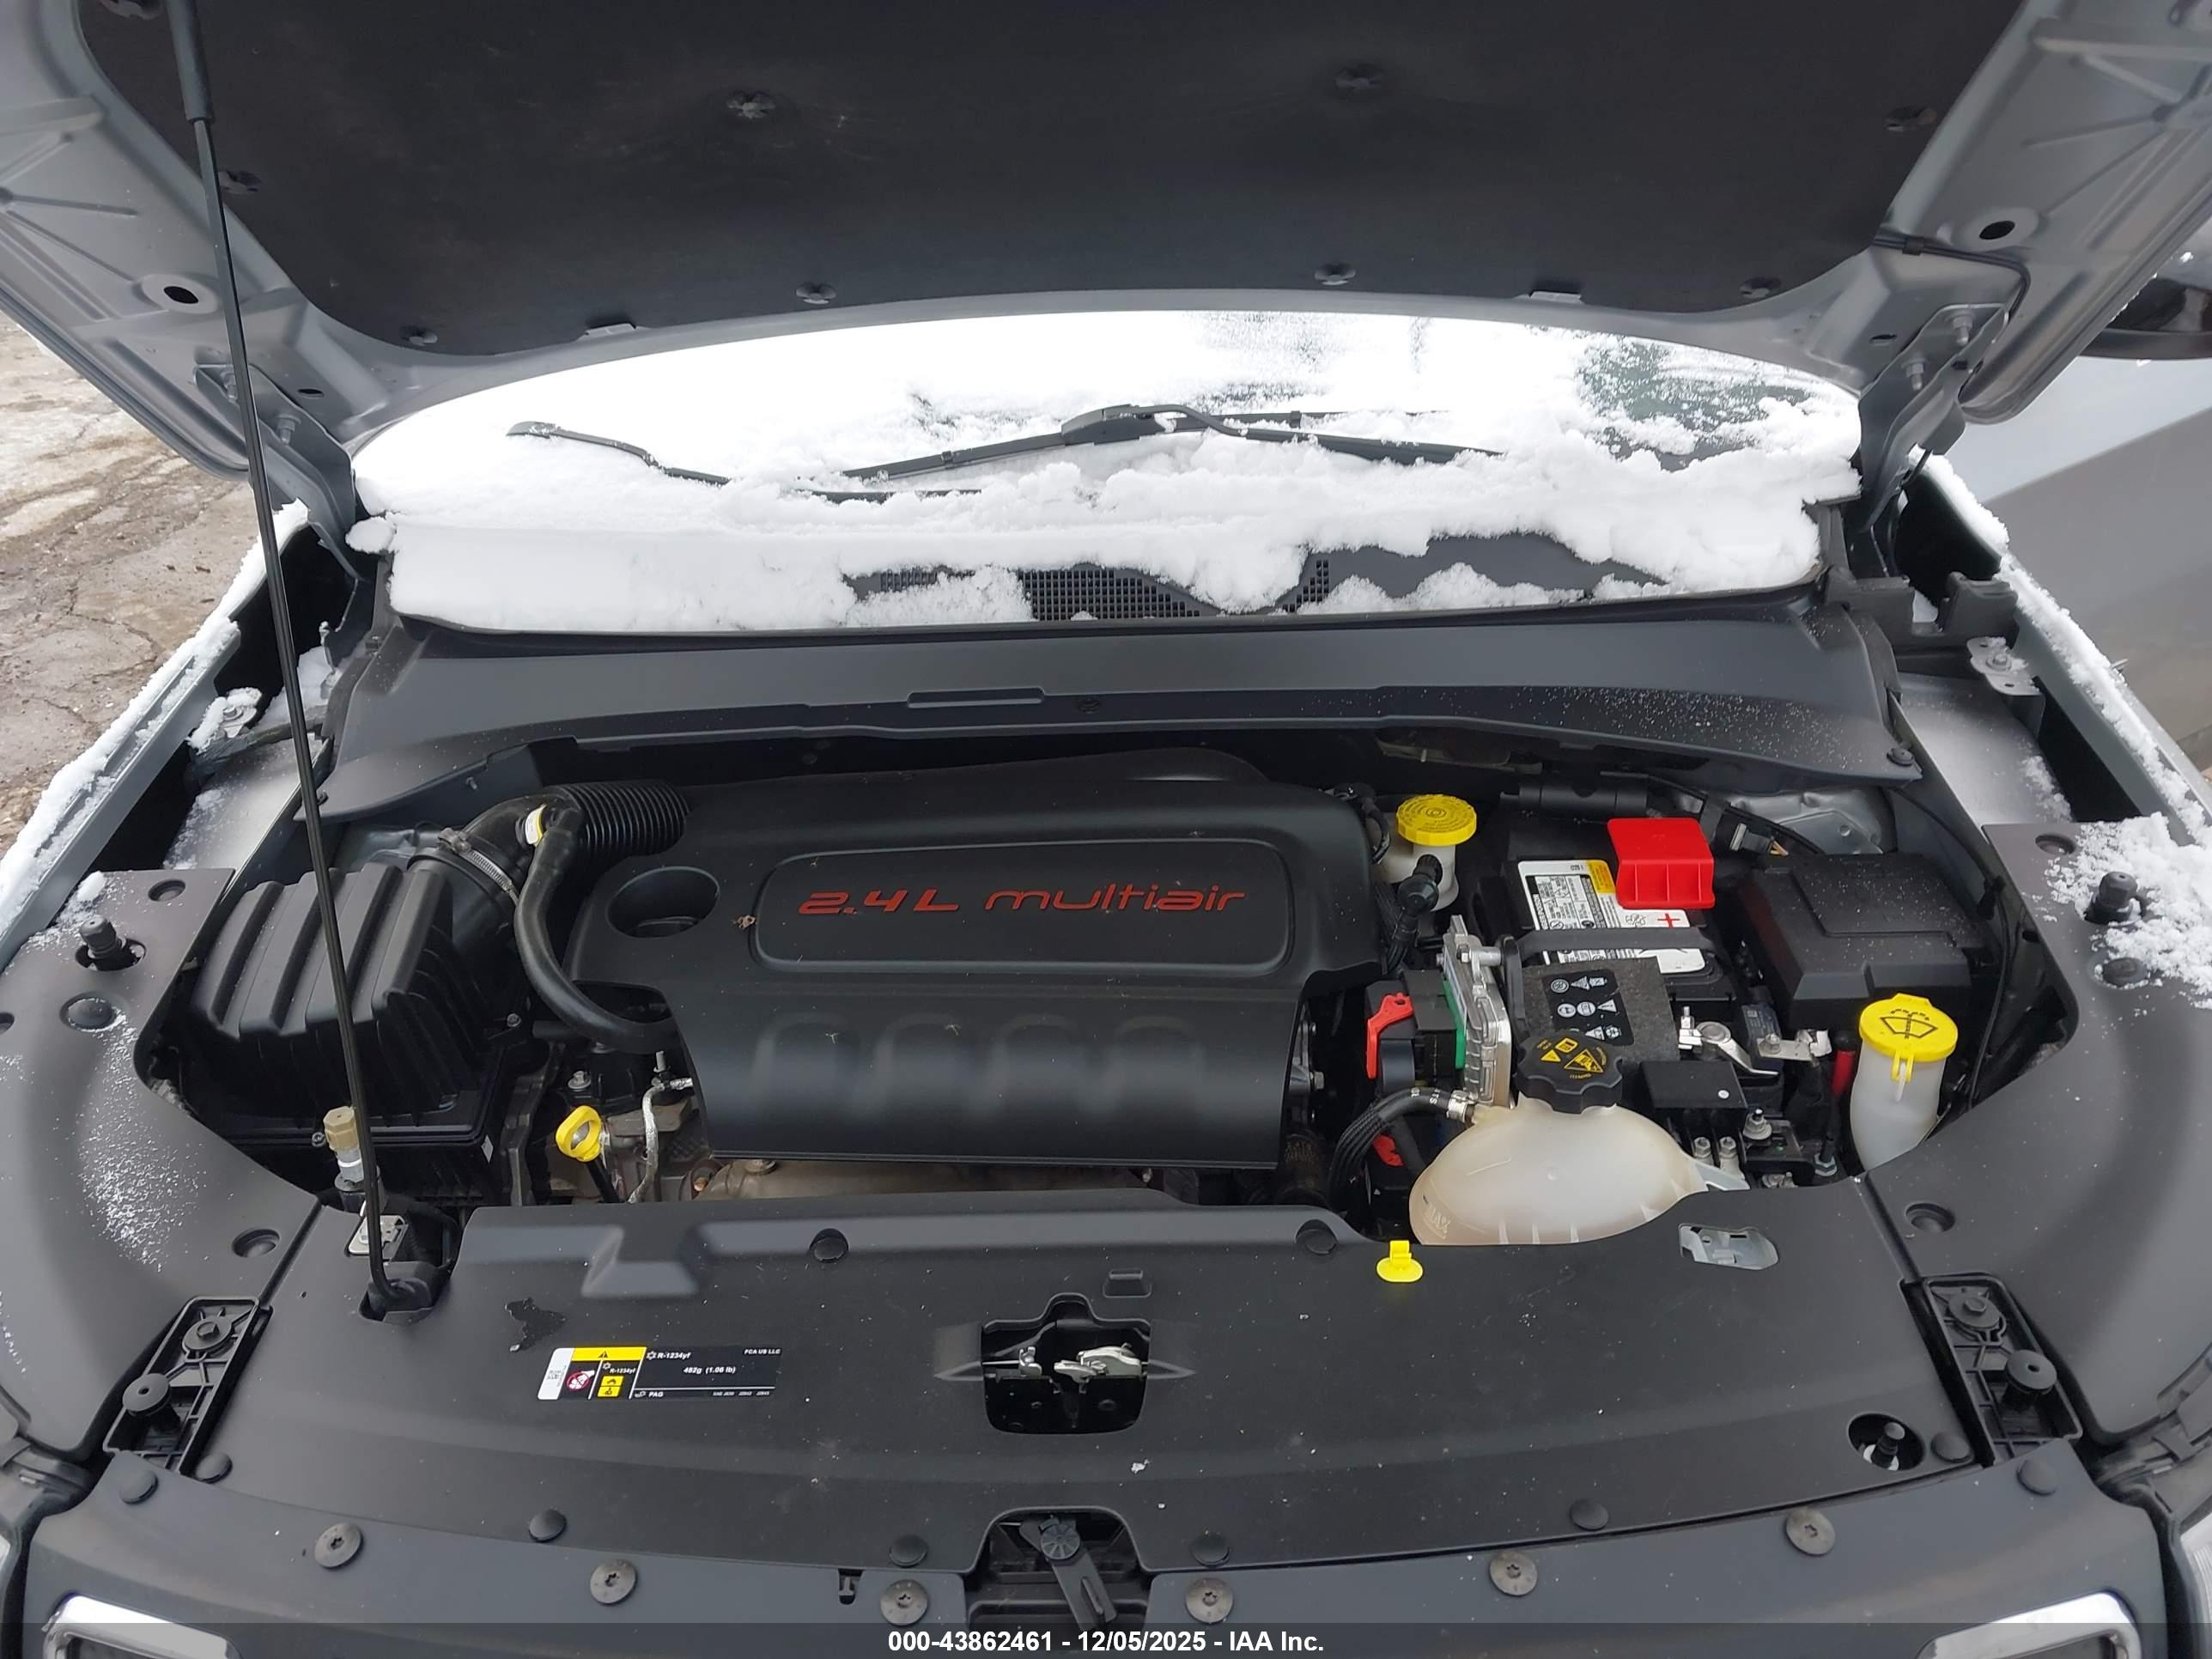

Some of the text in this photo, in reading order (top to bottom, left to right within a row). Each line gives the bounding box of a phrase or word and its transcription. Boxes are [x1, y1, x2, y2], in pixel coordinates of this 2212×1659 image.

[799, 884, 1245, 915] 2.4L multiair
[658, 1352, 691, 1360] R-1234yf
